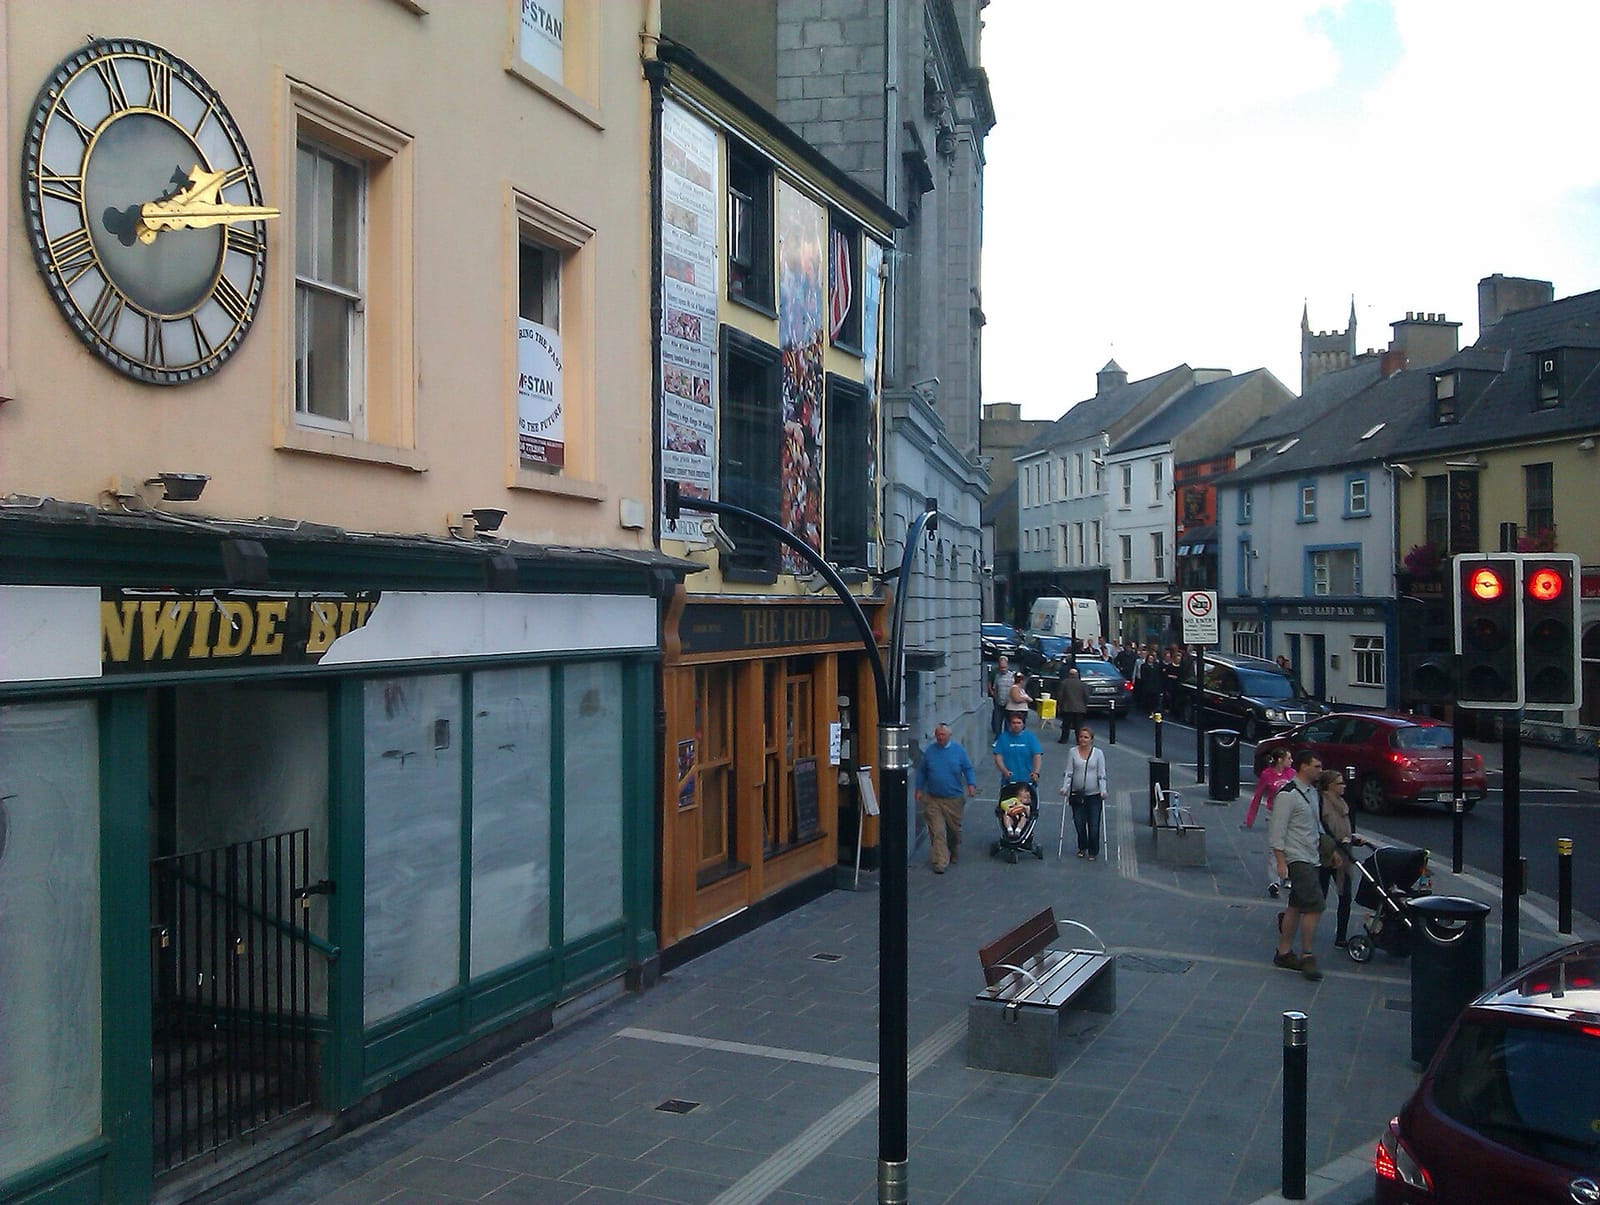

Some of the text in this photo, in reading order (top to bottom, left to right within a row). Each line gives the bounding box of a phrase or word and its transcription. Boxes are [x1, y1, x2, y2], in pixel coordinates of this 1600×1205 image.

[535, 332, 547, 349] THE
[548, 345, 562, 372] PAST
[540, 403, 563, 431] FUTURE
[742, 608, 831, 645] THE FIELD
